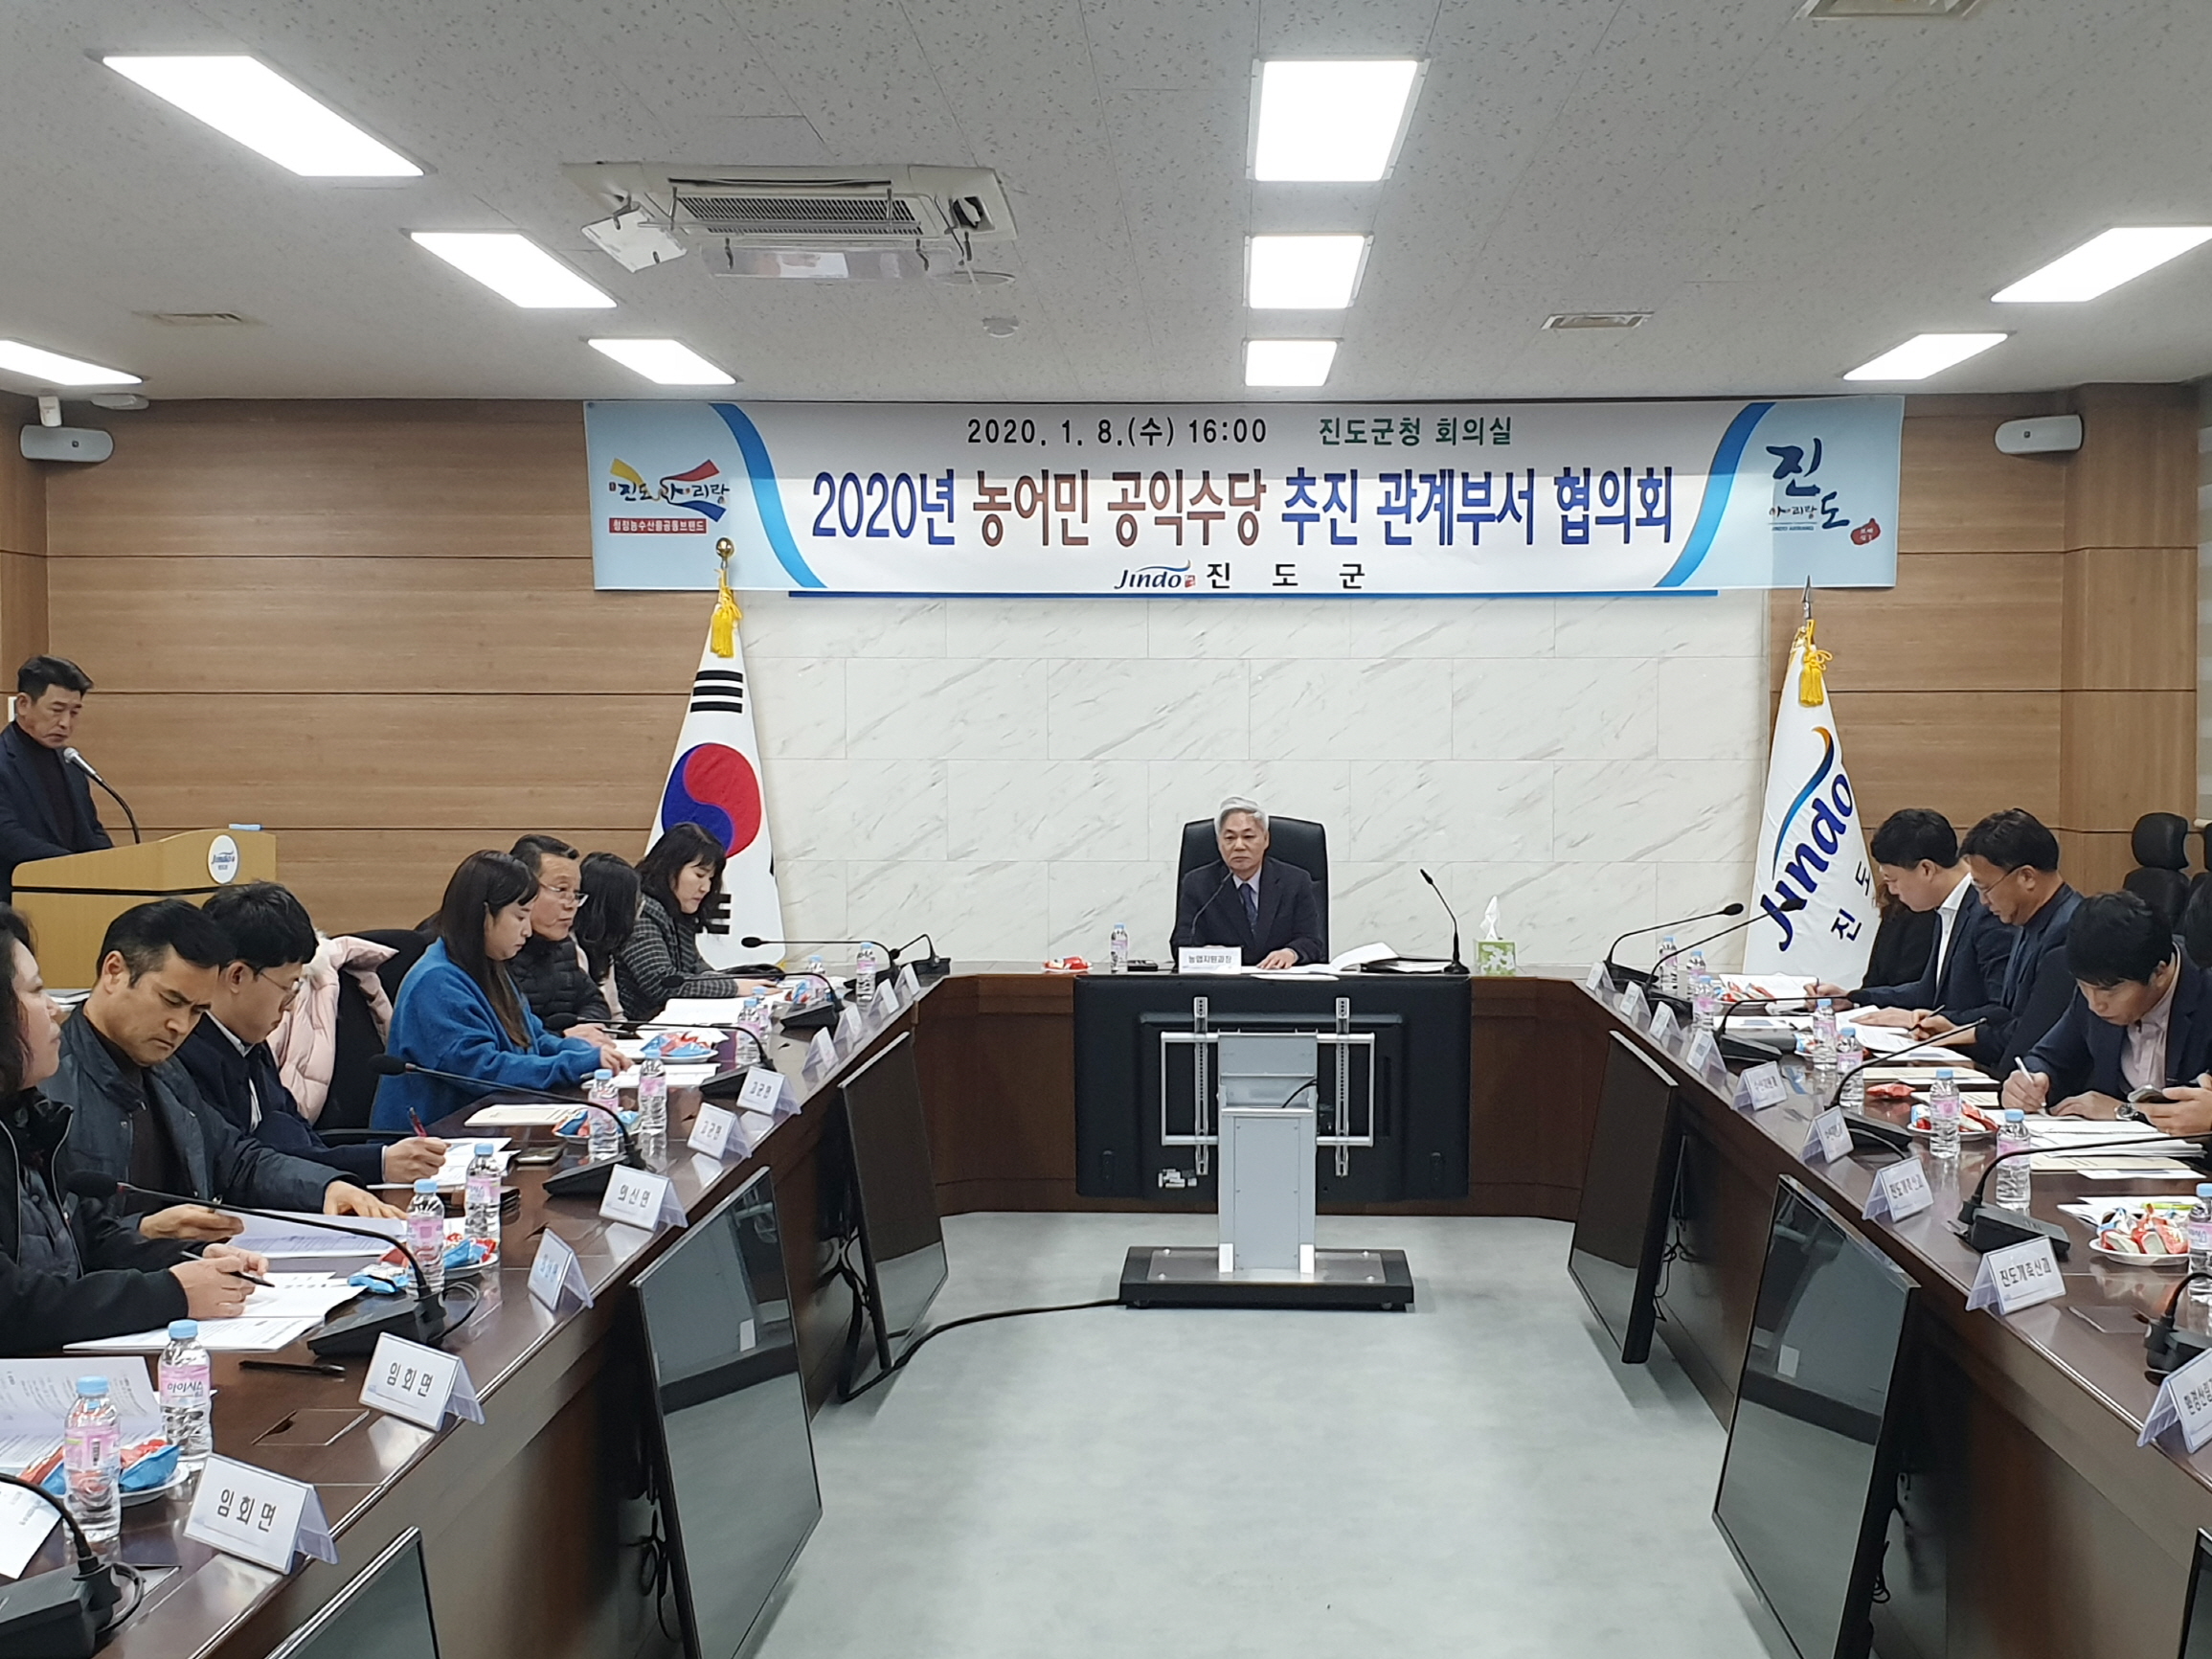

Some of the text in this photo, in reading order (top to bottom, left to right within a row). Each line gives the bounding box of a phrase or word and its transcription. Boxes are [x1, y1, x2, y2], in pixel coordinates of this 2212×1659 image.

[967, 416, 1267, 446] 2020. 1. 8.(수) 16:00
[1319, 416, 1512, 446] 진도군청 회의실
[812, 466, 1673, 547] 2020년 농어민 공익수당 추진 관계부서 협의회
[1114, 567, 1182, 589] Jindo
